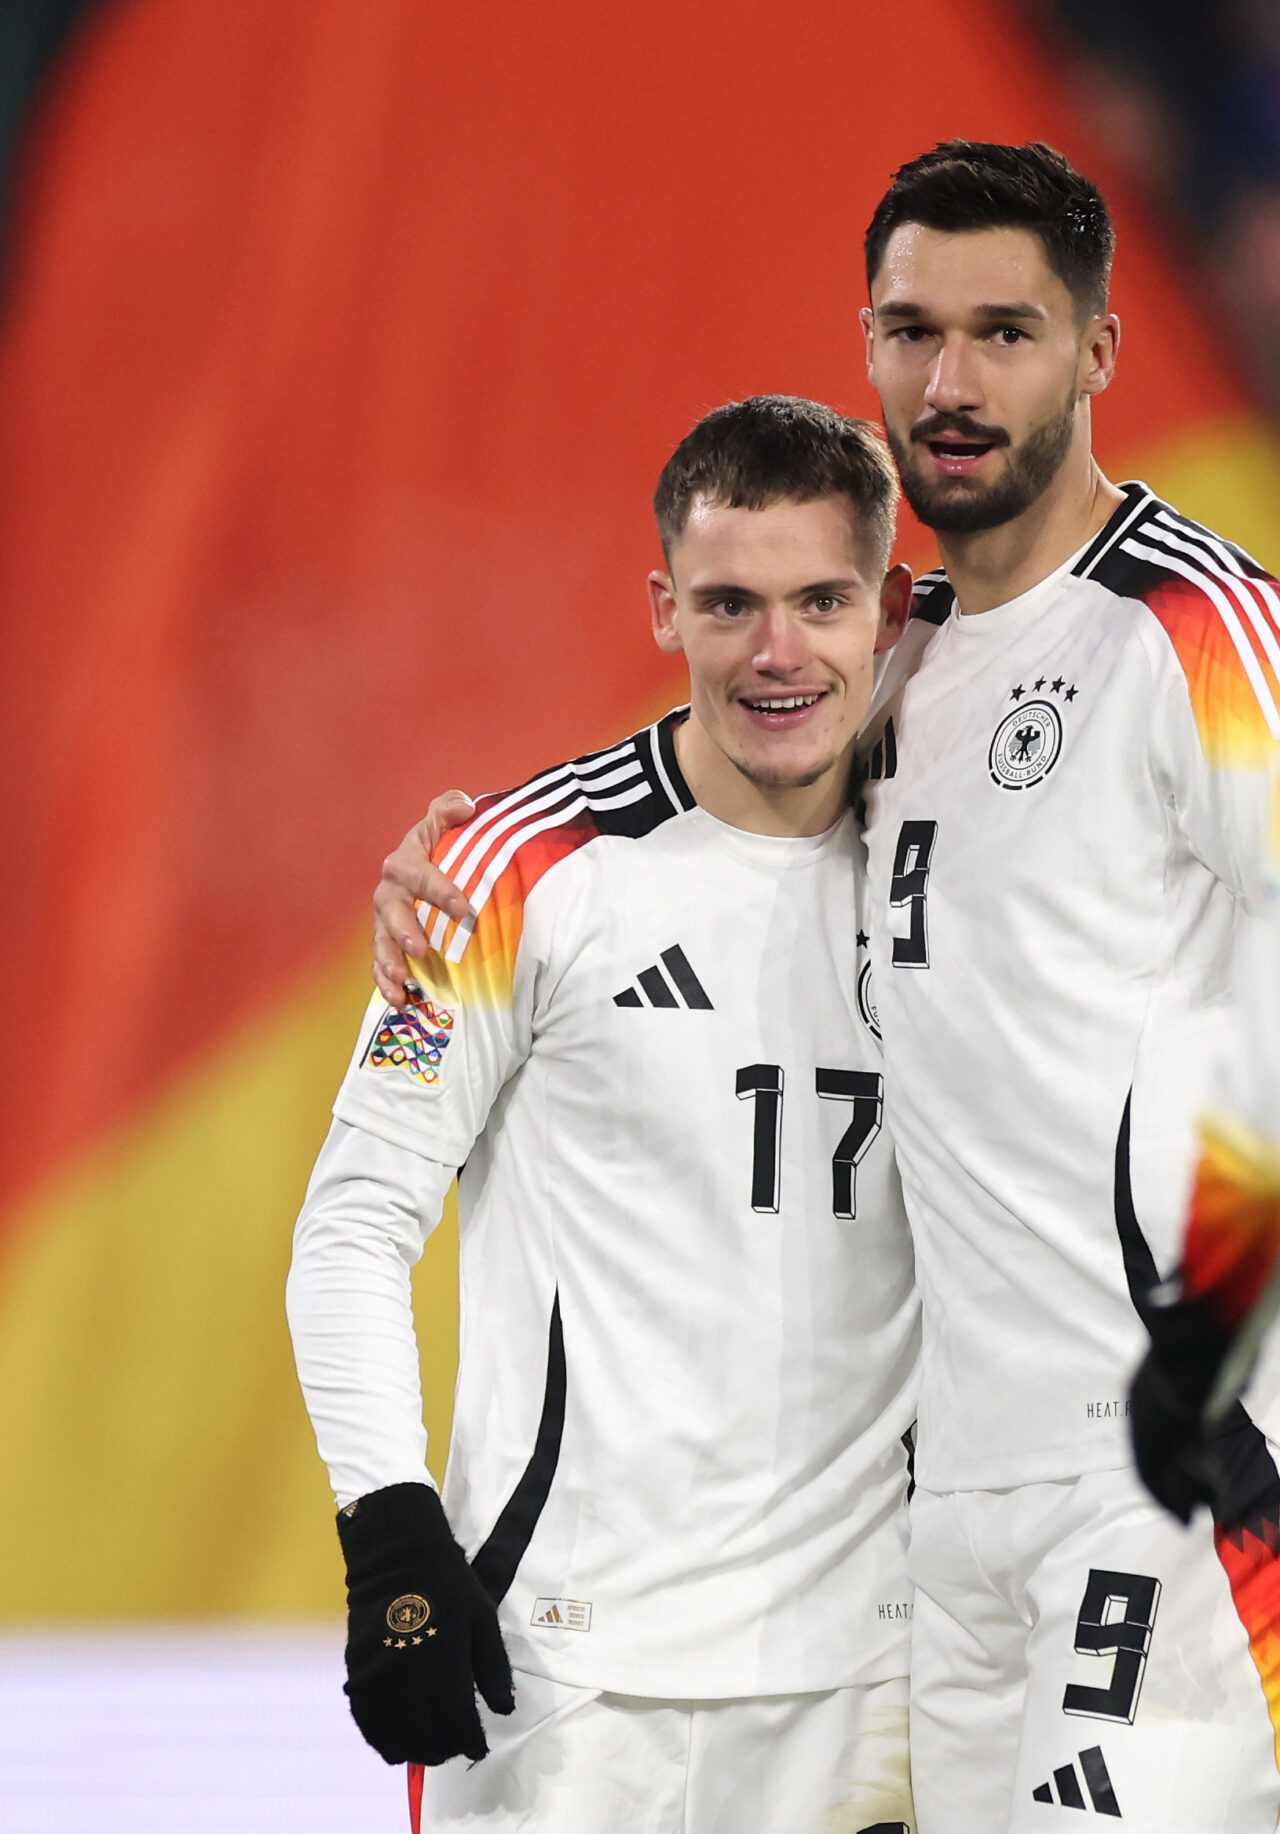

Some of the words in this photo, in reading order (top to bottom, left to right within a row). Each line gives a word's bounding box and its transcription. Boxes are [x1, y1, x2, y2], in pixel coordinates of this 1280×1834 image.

[1012, 711, 1051, 729] DEUTSCHER
[890, 820, 938, 969] 9
[736, 1063, 885, 1220] 17
[877, 1603, 914, 1620] HEAT.
[1062, 1568, 1162, 1726] 9
